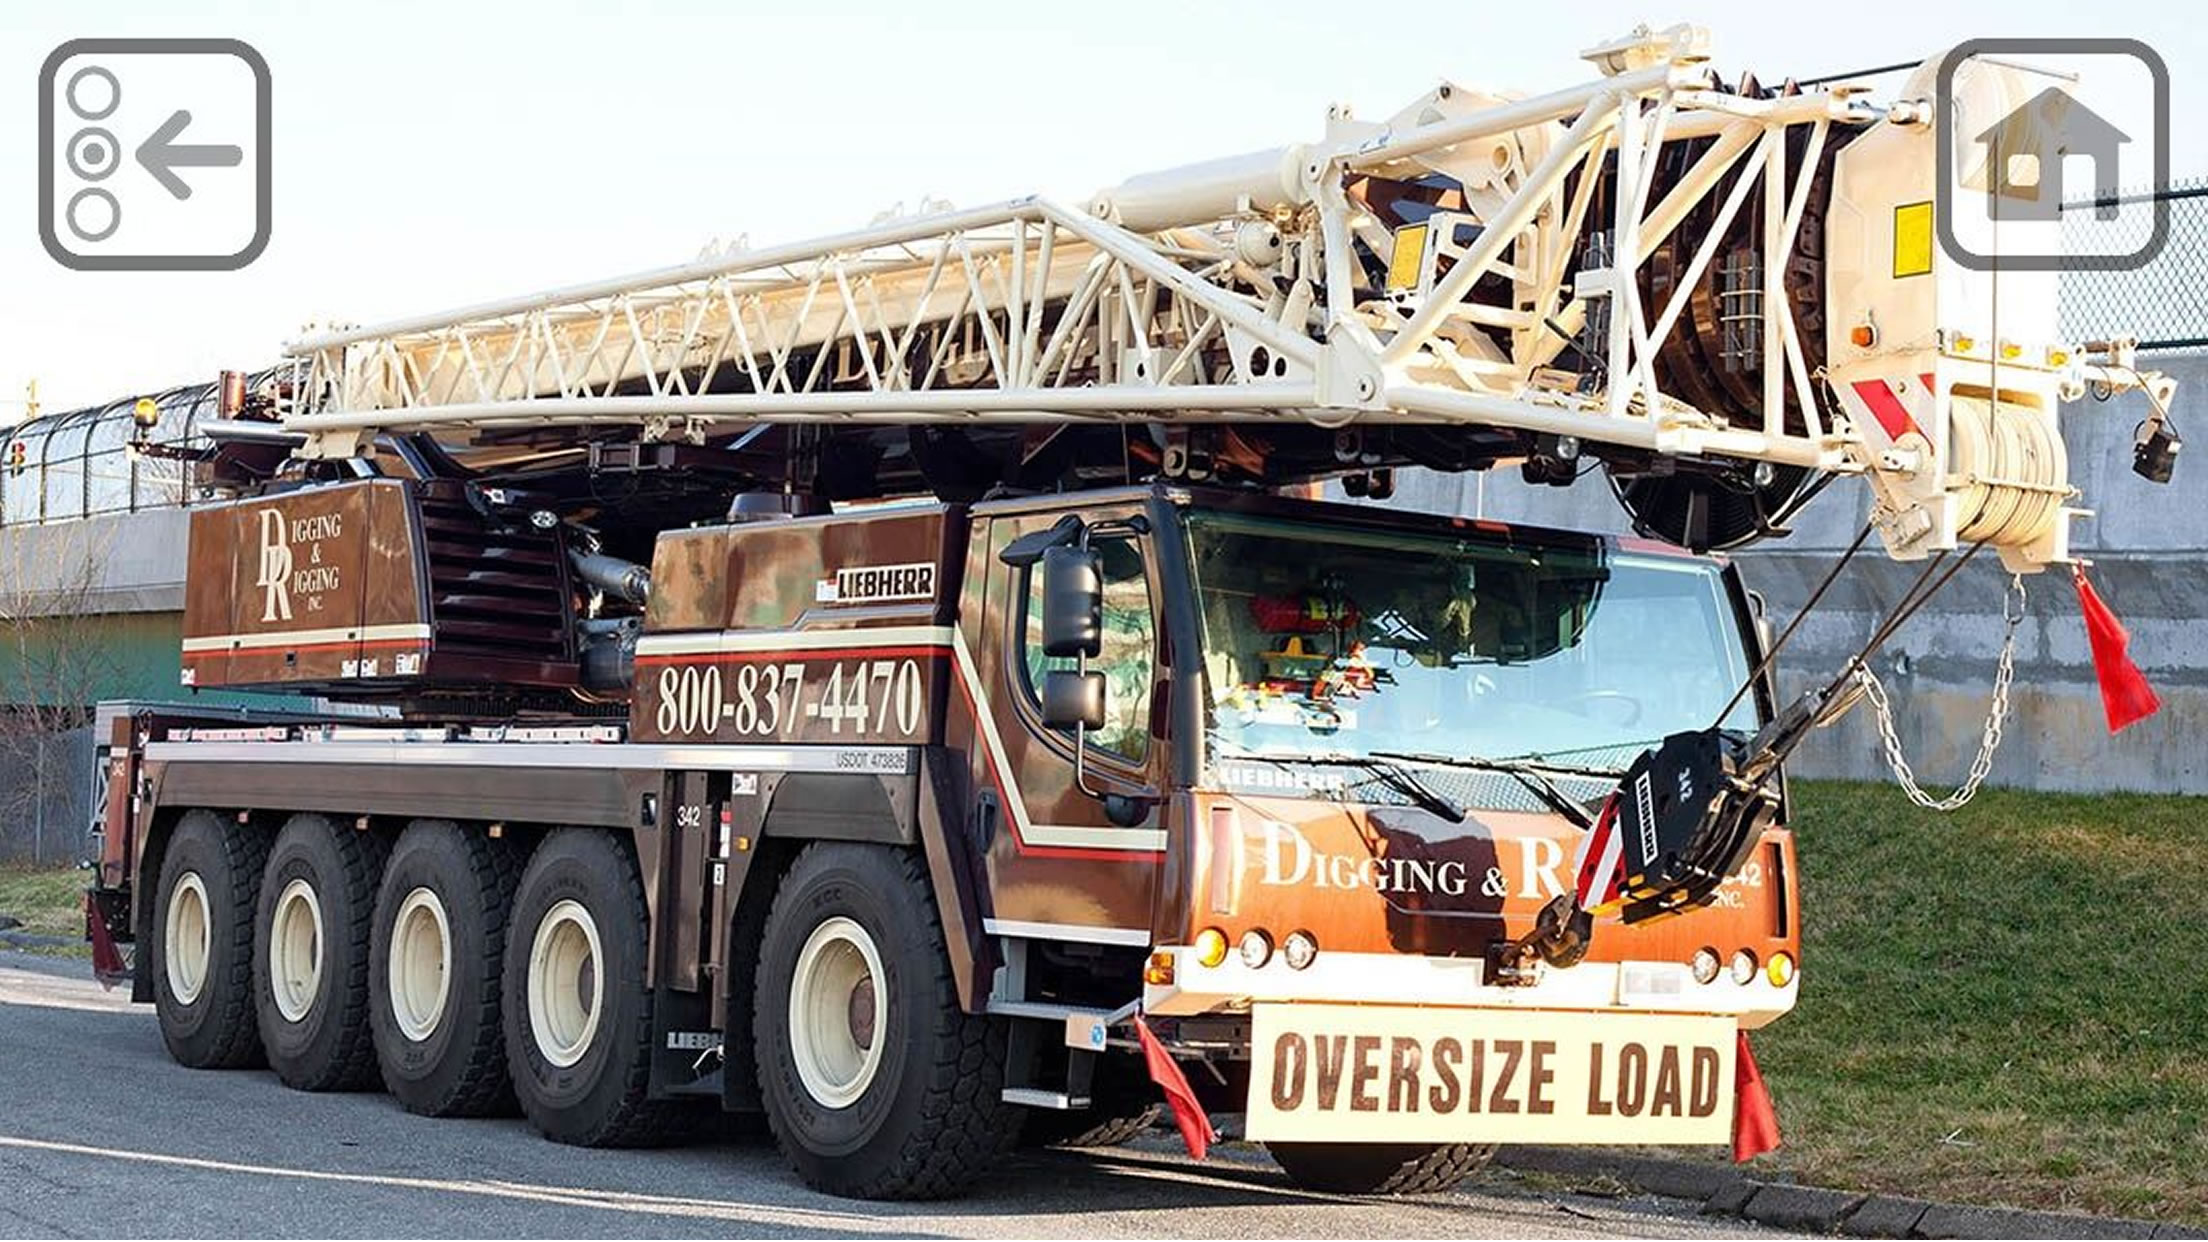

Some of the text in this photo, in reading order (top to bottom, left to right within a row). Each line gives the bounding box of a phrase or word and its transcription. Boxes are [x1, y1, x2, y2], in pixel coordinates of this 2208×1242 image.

[838, 567, 933, 599] LIEBHERR
[657, 659, 922, 736] 800-837-4470
[677, 805, 701, 828] 342
[1259, 820, 1469, 896] DIGGING
[1481, 868, 1508, 898] &
[1270, 1031, 1721, 1119] OVERSIZE LOAD
